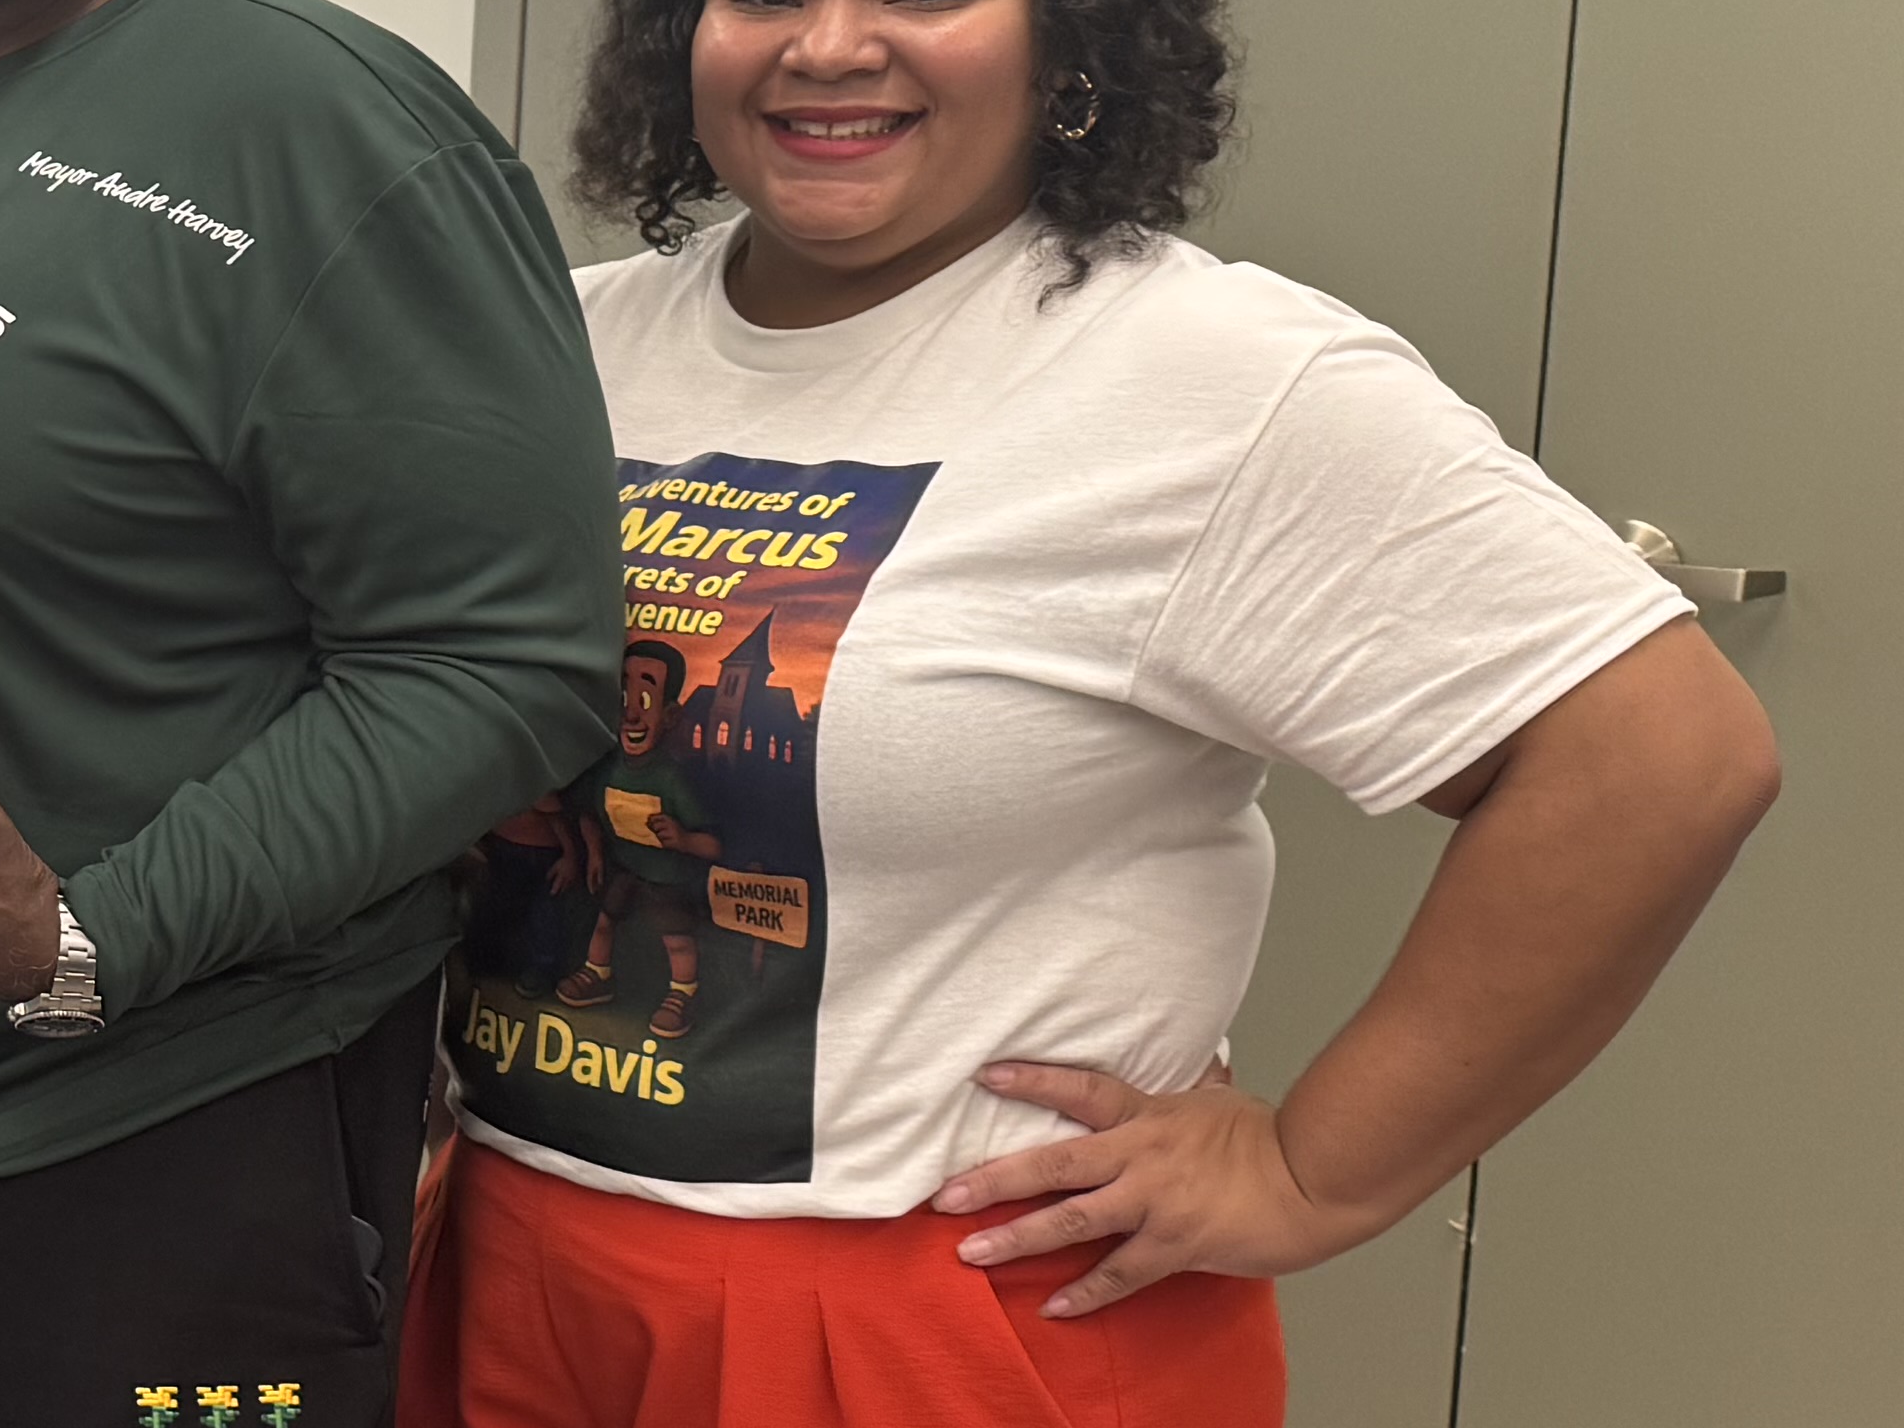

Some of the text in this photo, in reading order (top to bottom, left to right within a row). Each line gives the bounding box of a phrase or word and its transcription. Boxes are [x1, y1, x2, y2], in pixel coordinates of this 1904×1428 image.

[18, 151, 98, 192] Mayor
[168, 199, 254, 265] Harvey
[798, 492, 856, 519] of
[621, 507, 848, 570] Marcus
[624, 565, 748, 599] rets of
[624, 602, 723, 635] venue
[714, 879, 804, 908] MEMORIAL
[735, 903, 784, 932] PARK
[463, 988, 685, 1105] Jay Davis
